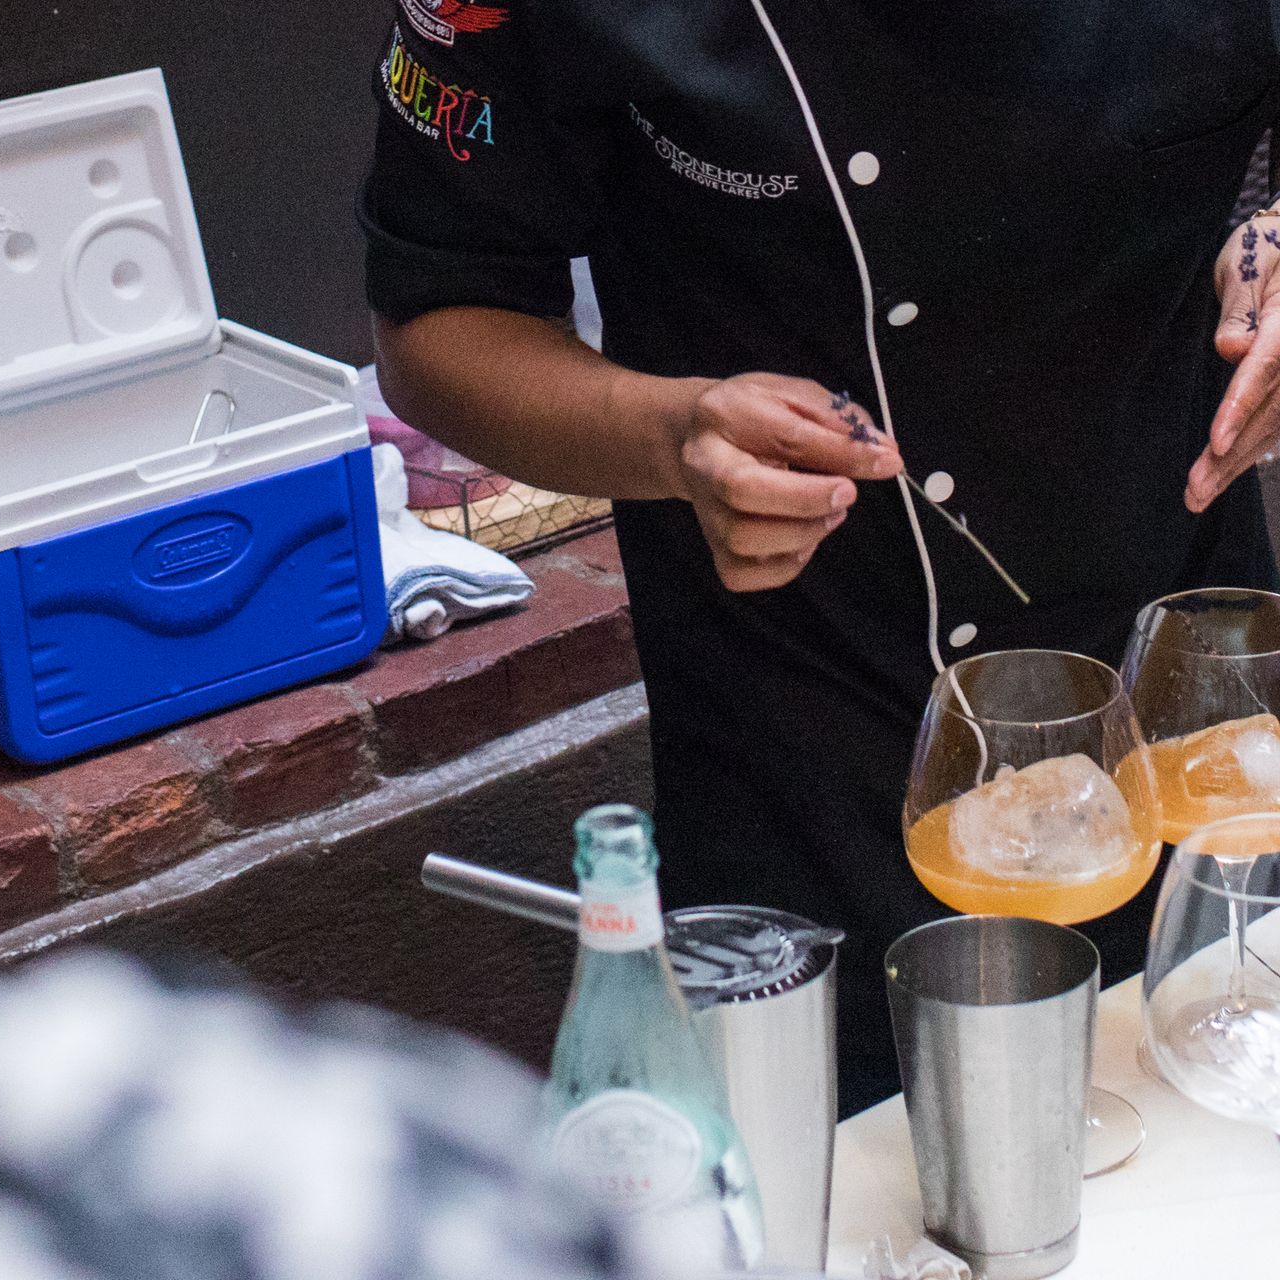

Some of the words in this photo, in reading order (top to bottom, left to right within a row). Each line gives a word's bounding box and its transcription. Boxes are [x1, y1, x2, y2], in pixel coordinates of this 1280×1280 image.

[387, 20, 495, 161] QUERIA
[416, 120, 440, 140] BAR
[628, 102, 655, 140] THE
[655, 135, 799, 199] STONEHOUSE
[685, 171, 719, 190] CLOVE
[720, 183, 761, 200] LAKES
